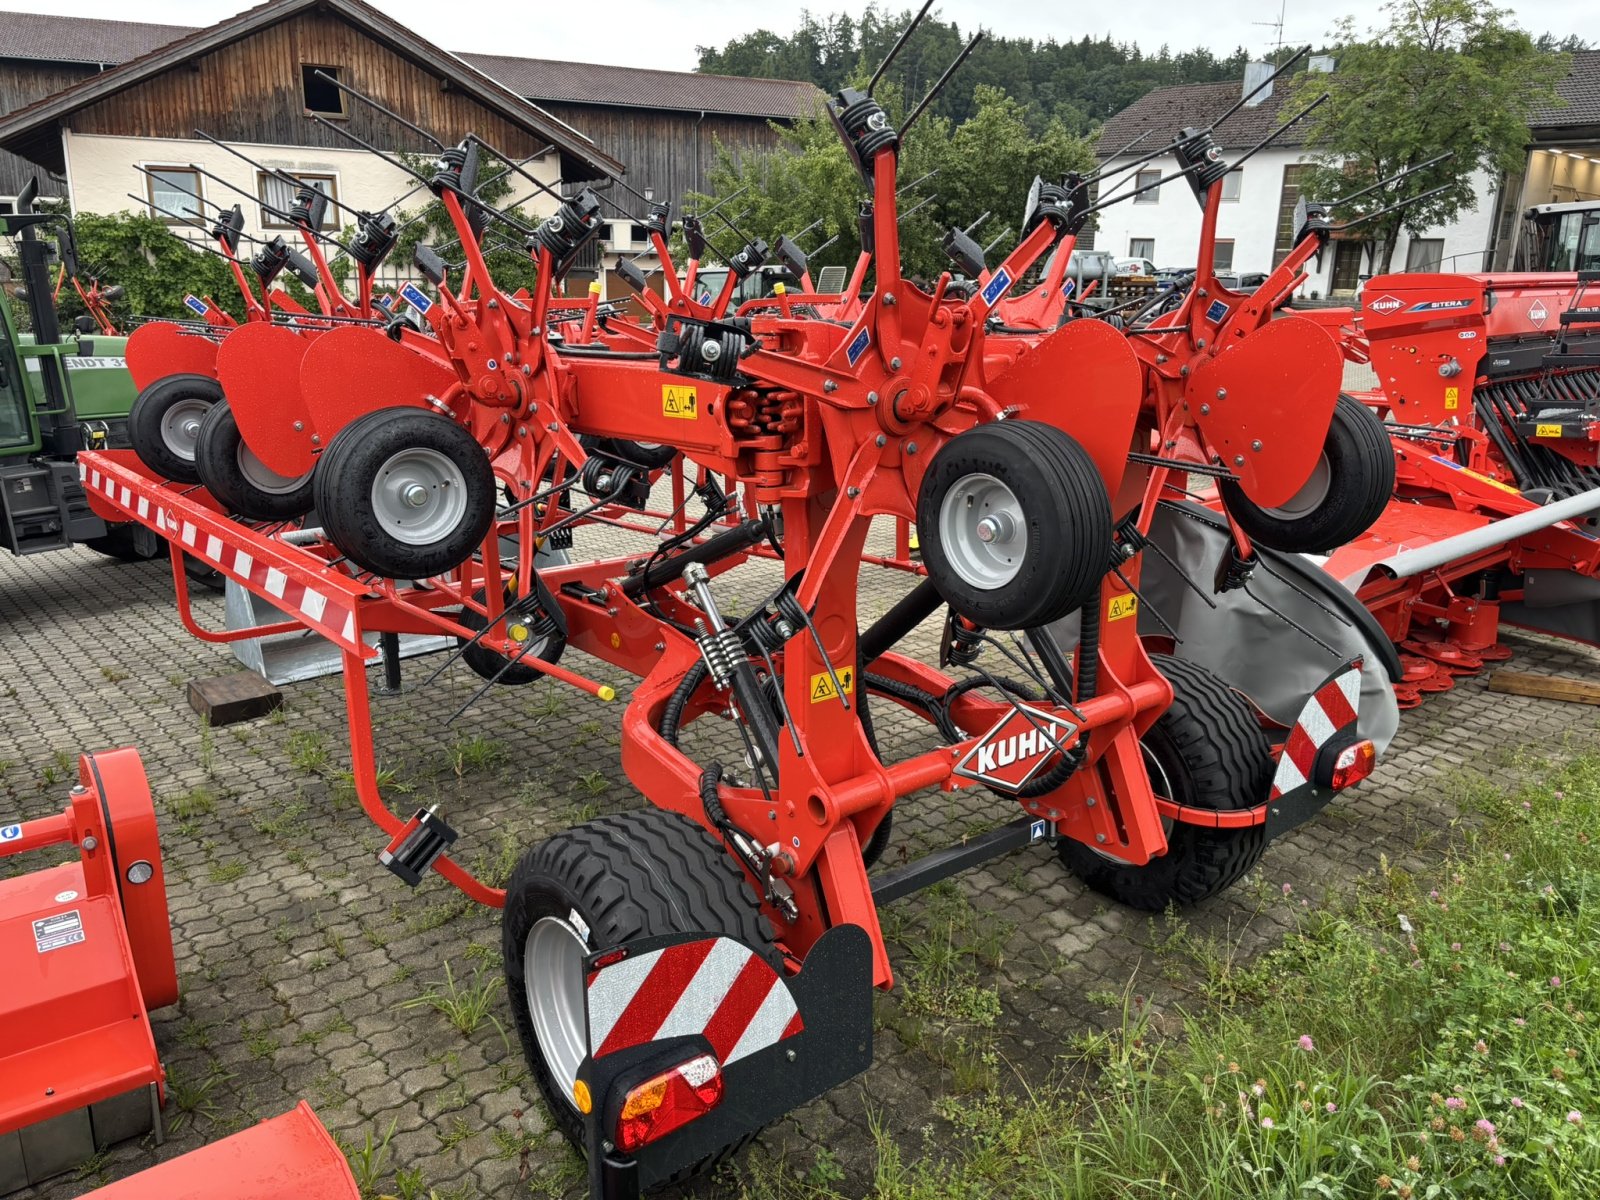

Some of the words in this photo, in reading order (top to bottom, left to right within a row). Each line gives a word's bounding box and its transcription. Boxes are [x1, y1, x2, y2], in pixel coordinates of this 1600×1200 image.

[1373, 301, 1400, 310] KUHN
[1431, 300, 1463, 309] SITERA
[65, 358, 105, 368] ENDT
[978, 722, 1057, 774] KUHN
